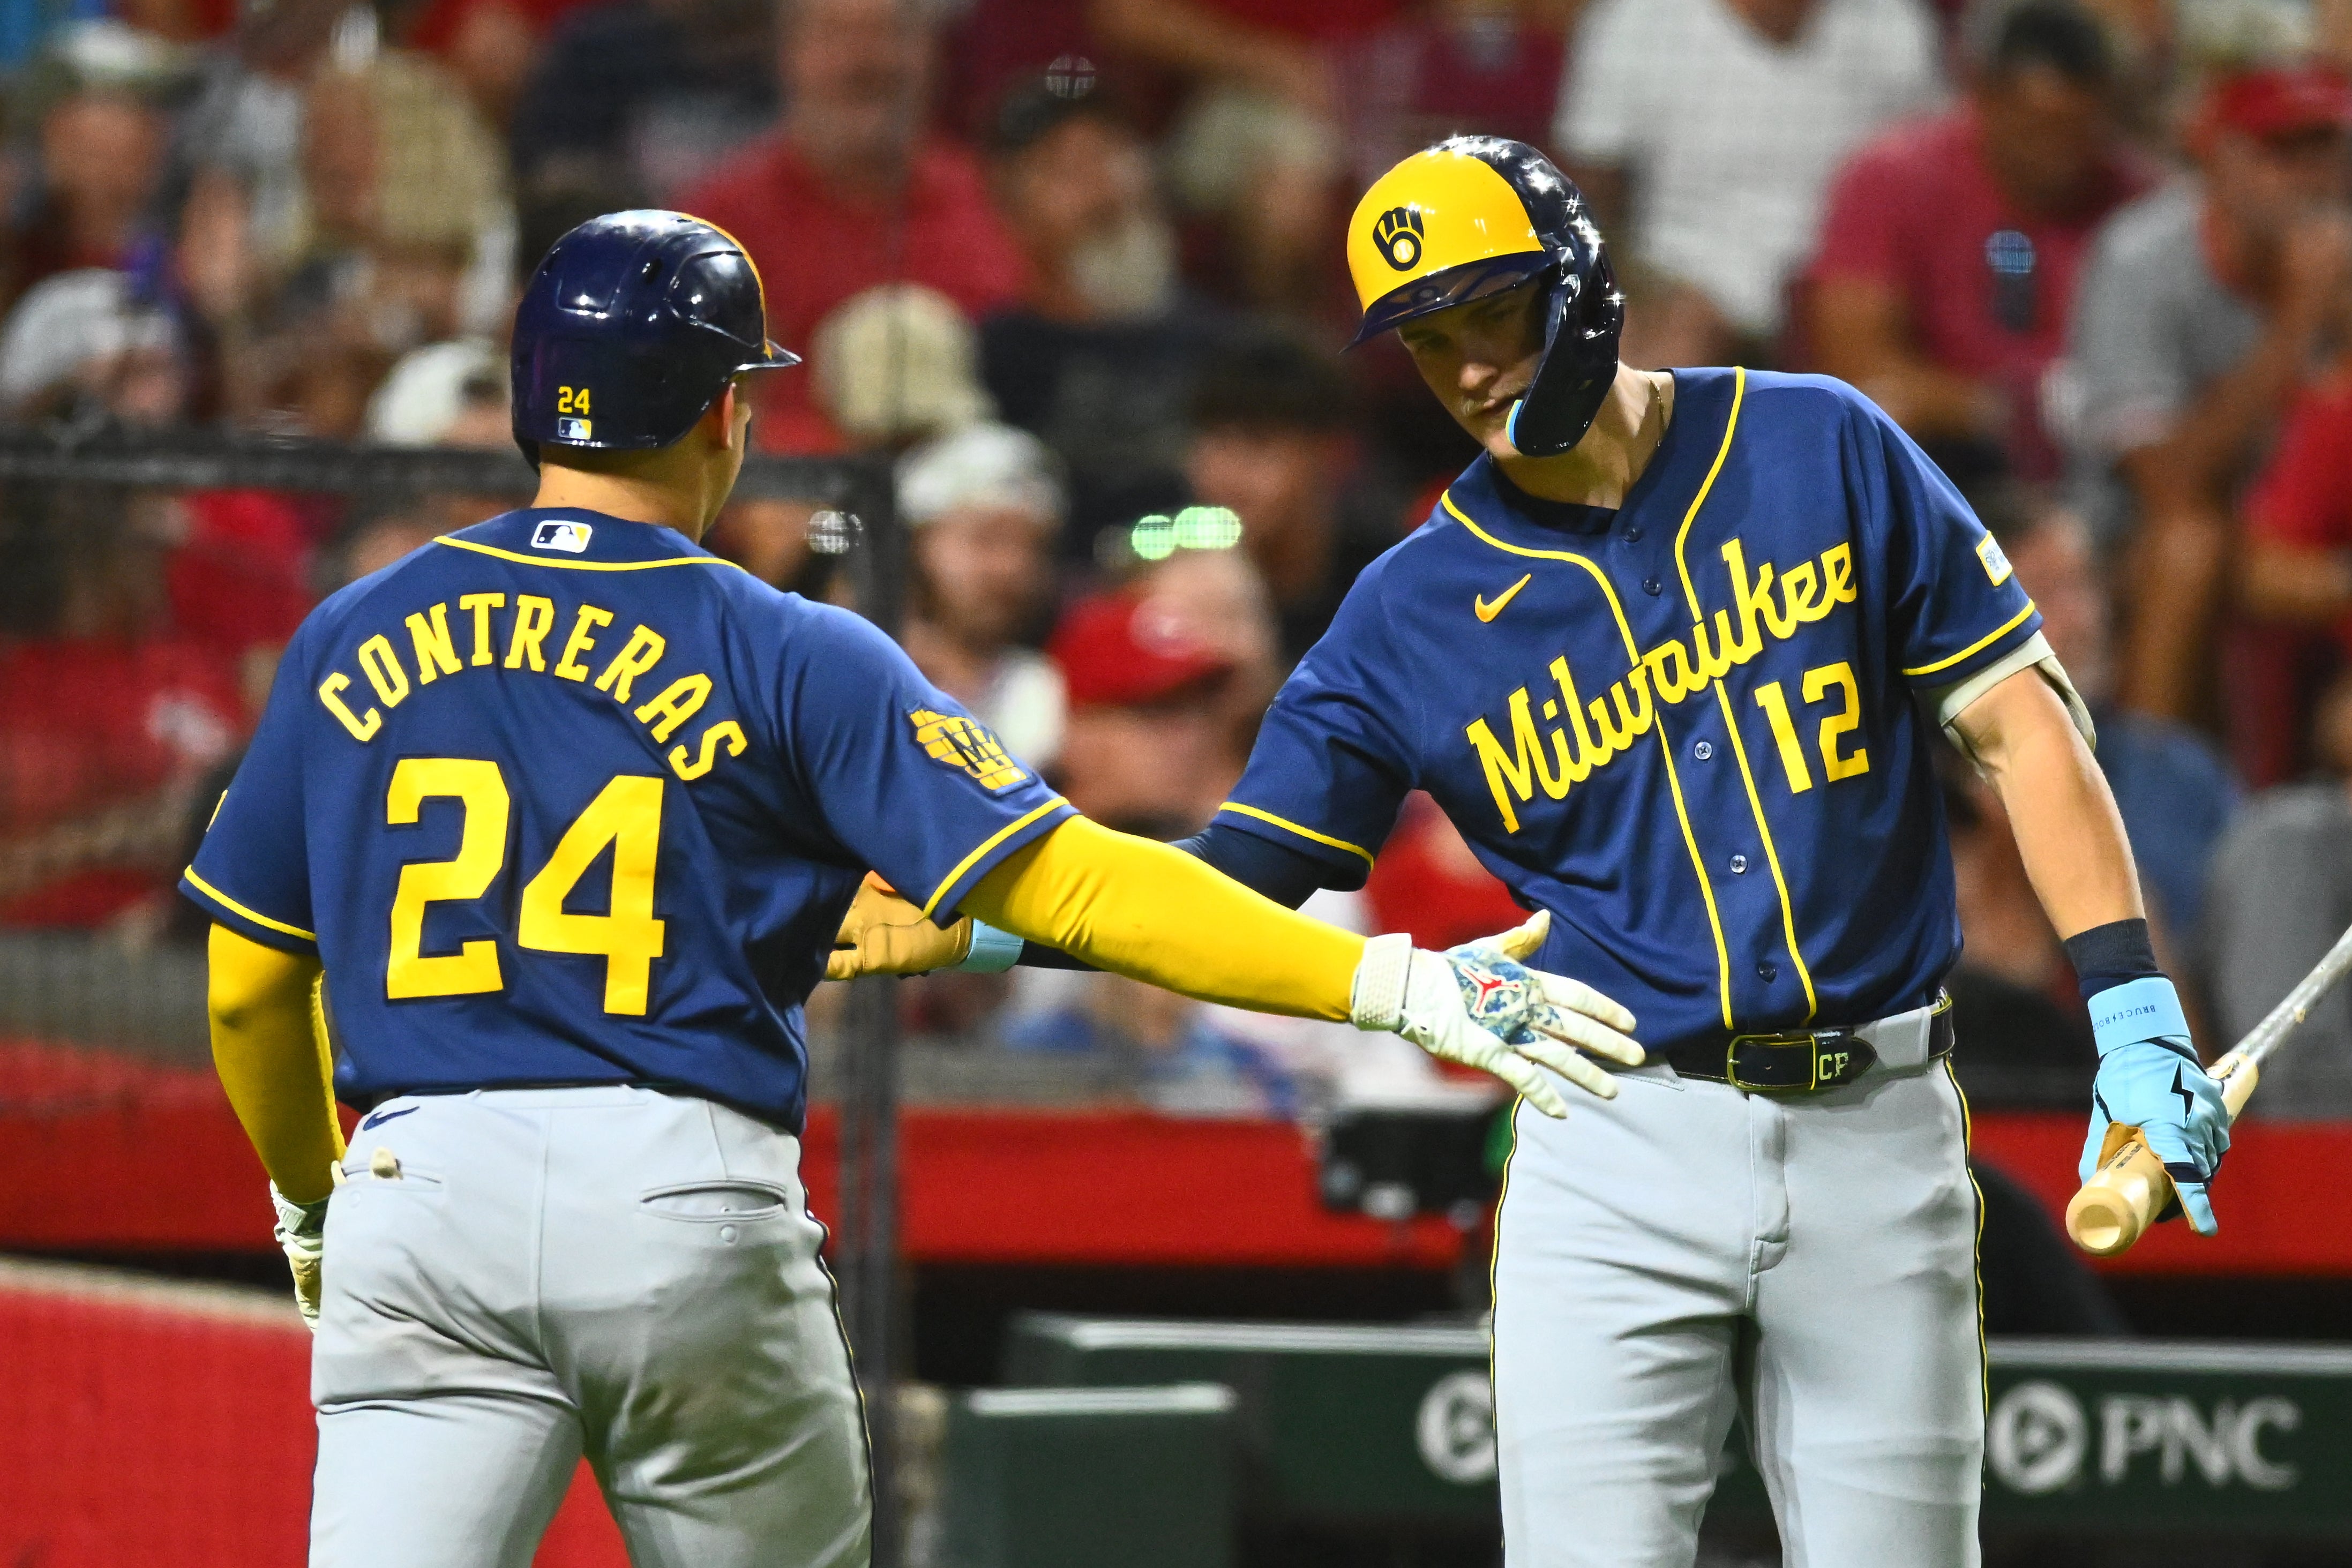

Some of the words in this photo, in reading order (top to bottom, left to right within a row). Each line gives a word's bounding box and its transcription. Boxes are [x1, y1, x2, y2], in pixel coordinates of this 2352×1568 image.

[557, 385, 590, 416] 24
[318, 591, 748, 782] CONTRERAS
[1465, 536, 1857, 835] Milwaukee
[1754, 659, 1870, 795] 12
[386, 756, 665, 1017] 24
[2118, 1004, 2156, 1020] BRUCE
[2099, 1395, 2298, 1490] PNC
